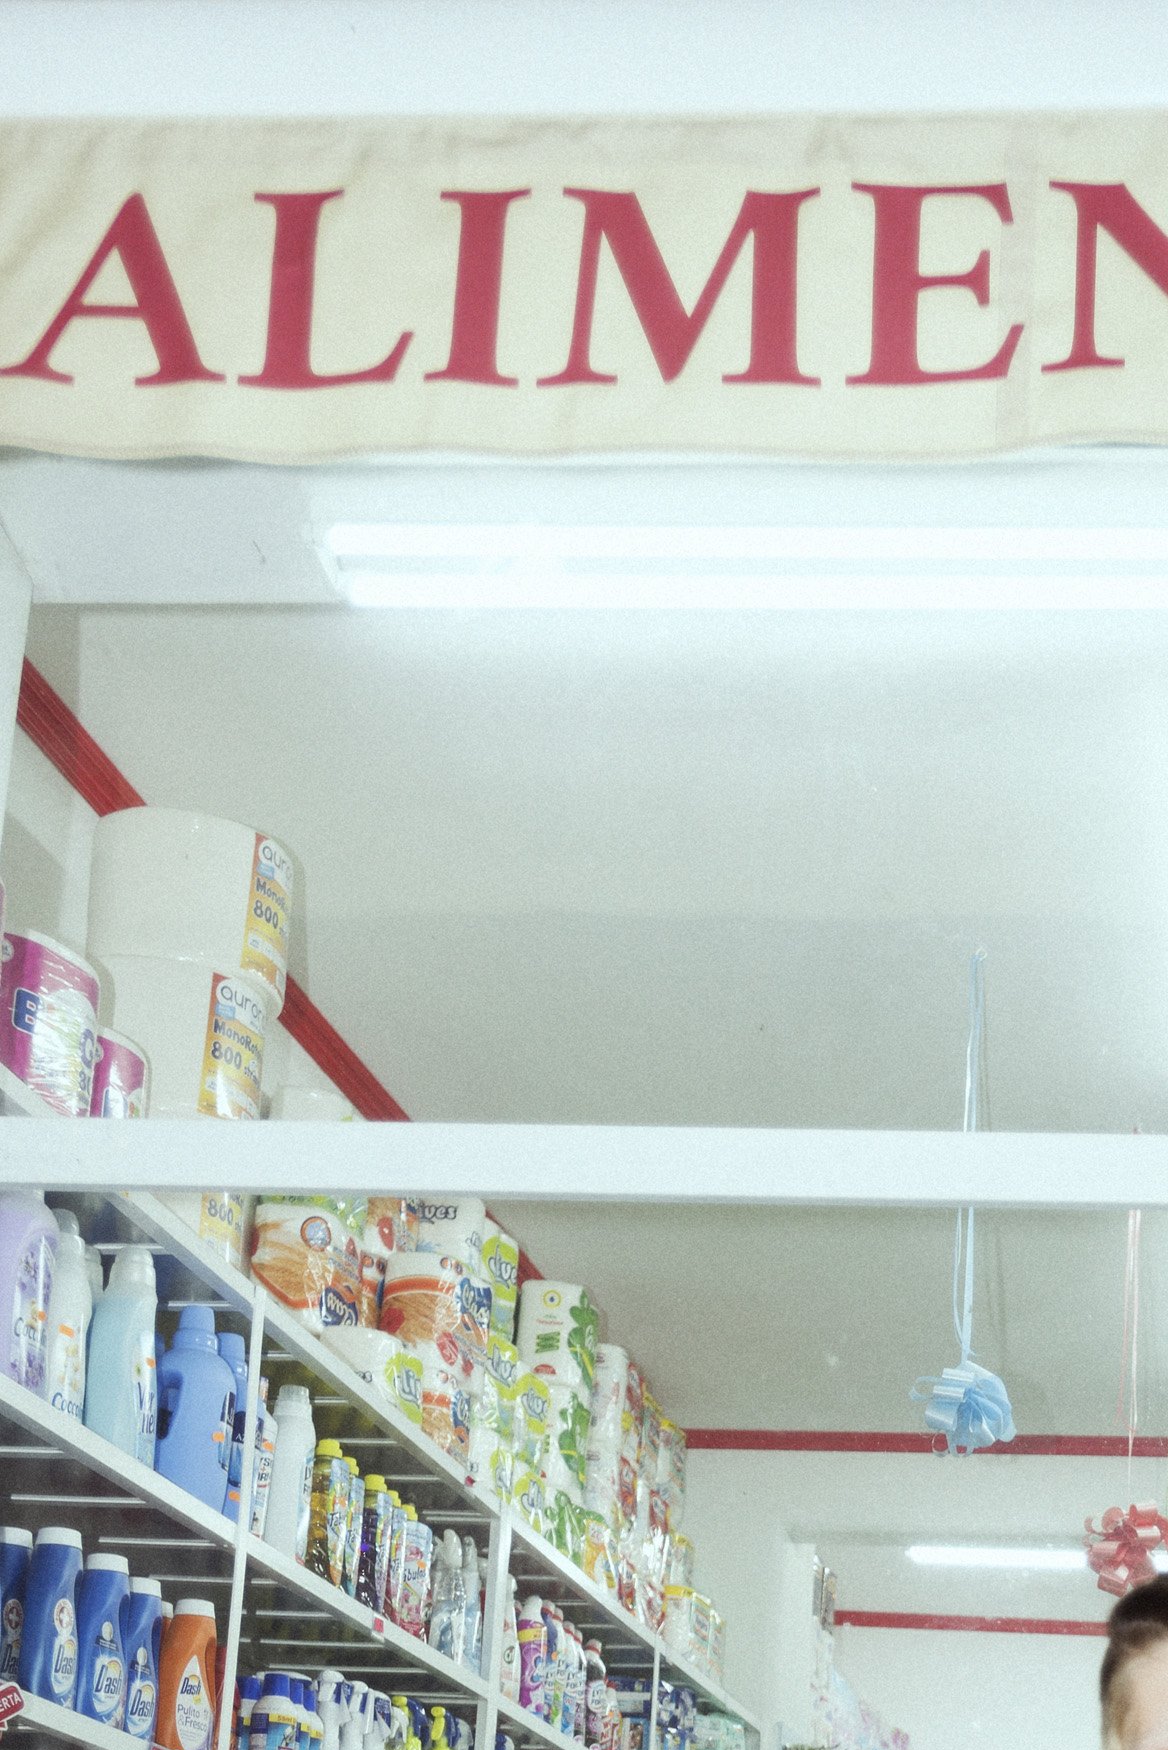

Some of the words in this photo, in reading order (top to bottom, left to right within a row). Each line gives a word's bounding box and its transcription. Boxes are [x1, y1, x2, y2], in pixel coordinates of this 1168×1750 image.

[253, 899, 279, 930] 800
[211, 1041, 243, 1071] 800
[207, 1199, 235, 1224] 800
[95, 1665, 122, 1695] Dash
[180, 1676, 202, 1695] Dash
[130, 1688, 156, 1718] Dash
[177, 1703, 200, 1717] Pulito
